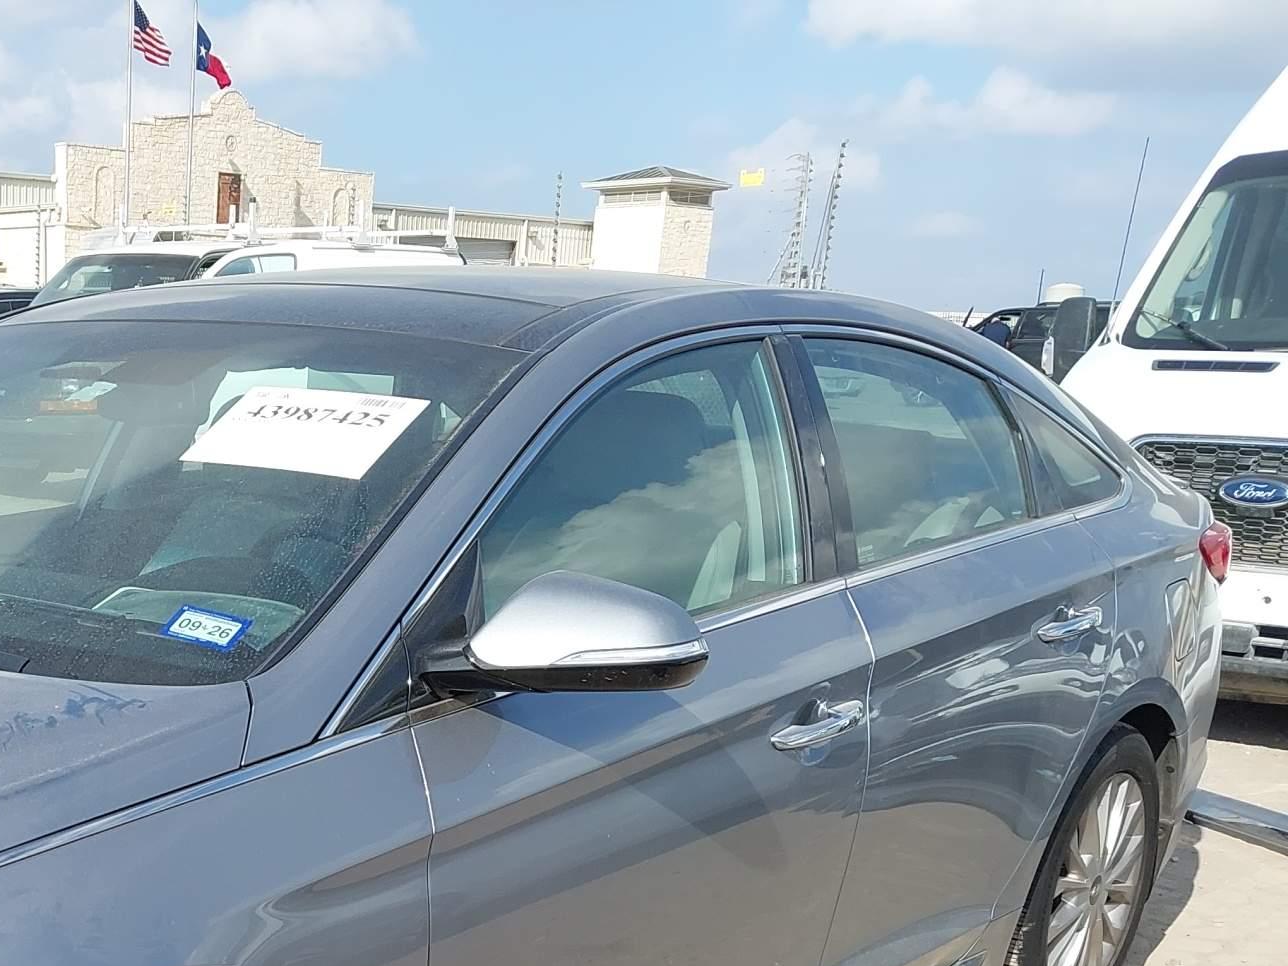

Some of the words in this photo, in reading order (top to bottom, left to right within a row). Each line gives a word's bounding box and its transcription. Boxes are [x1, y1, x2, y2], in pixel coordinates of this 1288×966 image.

[247, 404, 392, 428] 43987425
[1233, 482, 1278, 500] Ford
[207, 625, 233, 639] 26
